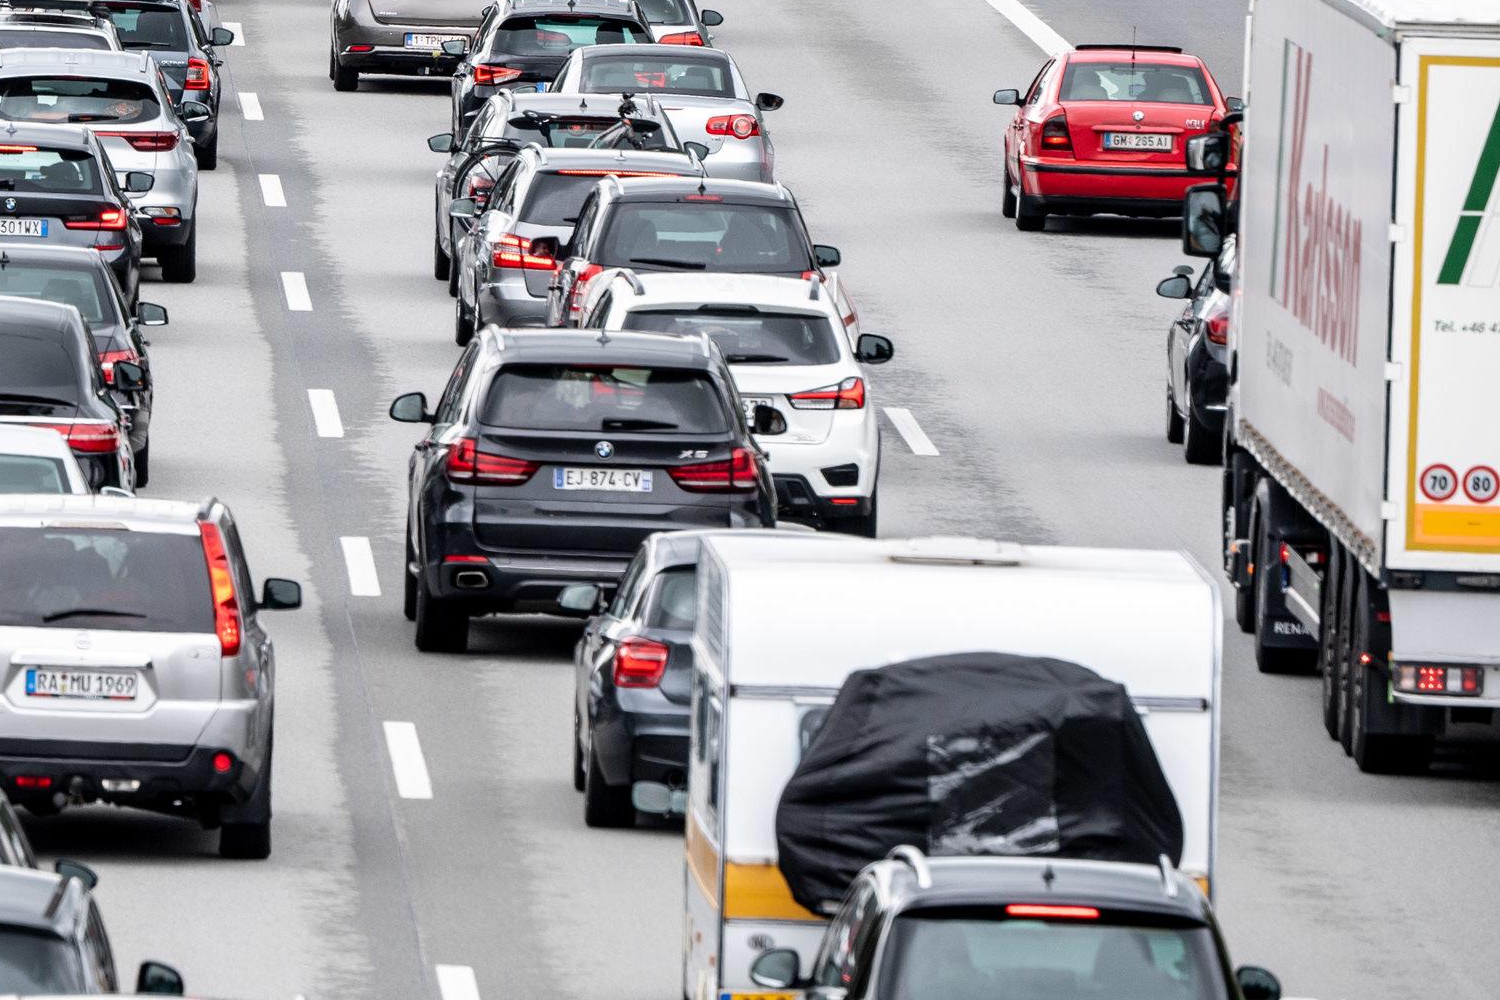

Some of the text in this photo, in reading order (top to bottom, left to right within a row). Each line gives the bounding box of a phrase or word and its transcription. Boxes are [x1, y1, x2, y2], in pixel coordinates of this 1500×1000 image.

[1113, 136, 1128, 147] GM
[1135, 136, 1154, 147] 265
[0, 220, 40, 235] 301WX
[678, 450, 709, 460] X5
[1430, 475, 1491, 493] 70 80
[1273, 621, 1310, 635] RENA
[37, 672, 136, 695] RA MU 1969
